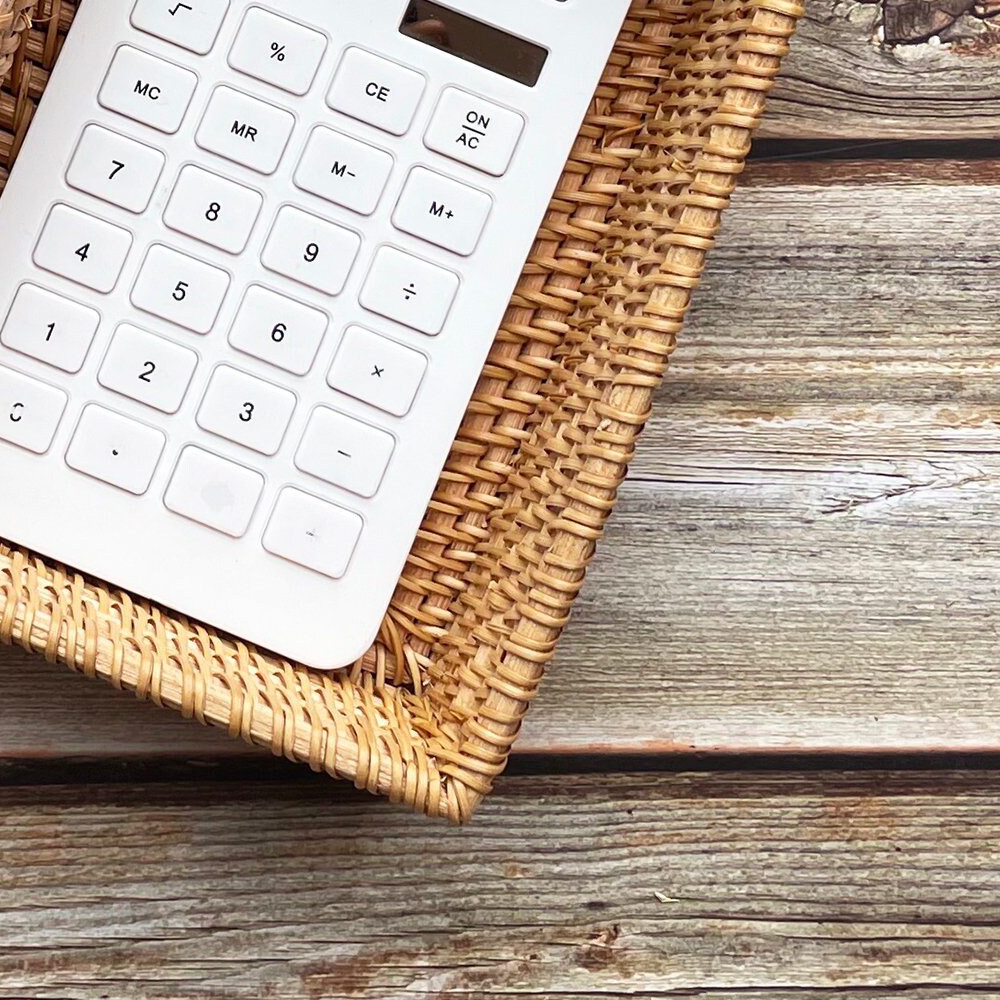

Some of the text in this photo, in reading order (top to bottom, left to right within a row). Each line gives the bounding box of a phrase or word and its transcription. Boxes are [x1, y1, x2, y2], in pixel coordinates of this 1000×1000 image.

[270, 41, 286, 62] %
[133, 79, 161, 100] MC
[365, 82, 391, 103] CE
[465, 110, 491, 130] ON
[230, 120, 258, 142] MR
[455, 132, 480, 150] AC
[108, 159, 125, 180] 7
[204, 202, 221, 222] 8
[428, 201, 454, 219] M+
[74, 242, 91, 262] 4
[303, 242, 319, 263] 9
[172, 280, 189, 302] 5
[45, 322, 56, 342] 1
[271, 322, 287, 343] 6
[138, 361, 156, 383] 2
[238, 402, 255, 422] 3
